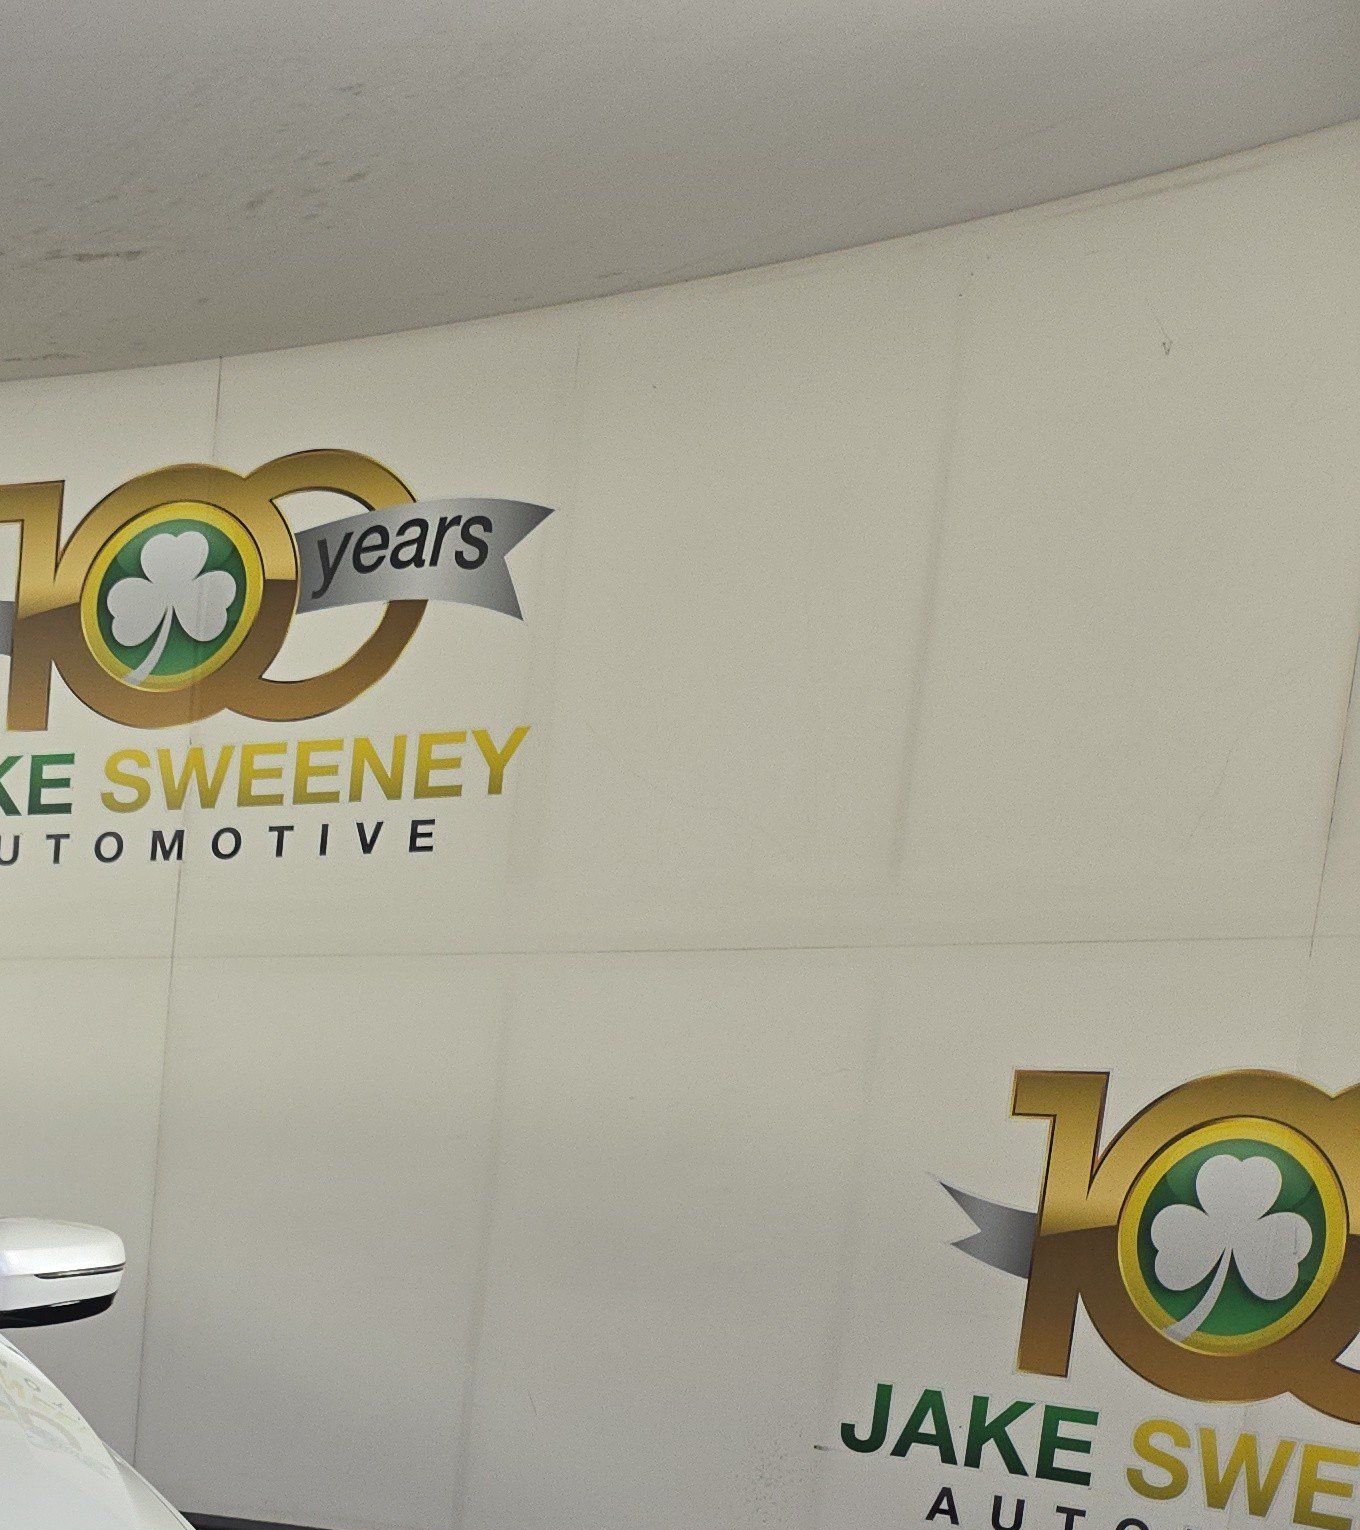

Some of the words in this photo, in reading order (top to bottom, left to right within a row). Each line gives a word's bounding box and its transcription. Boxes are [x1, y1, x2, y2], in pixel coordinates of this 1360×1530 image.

[312, 514, 494, 599] years
[100, 725, 532, 814] SWEENEY
[1011, 1068, 1360, 1425] 10
[840, 1382, 1100, 1487] JAKE
